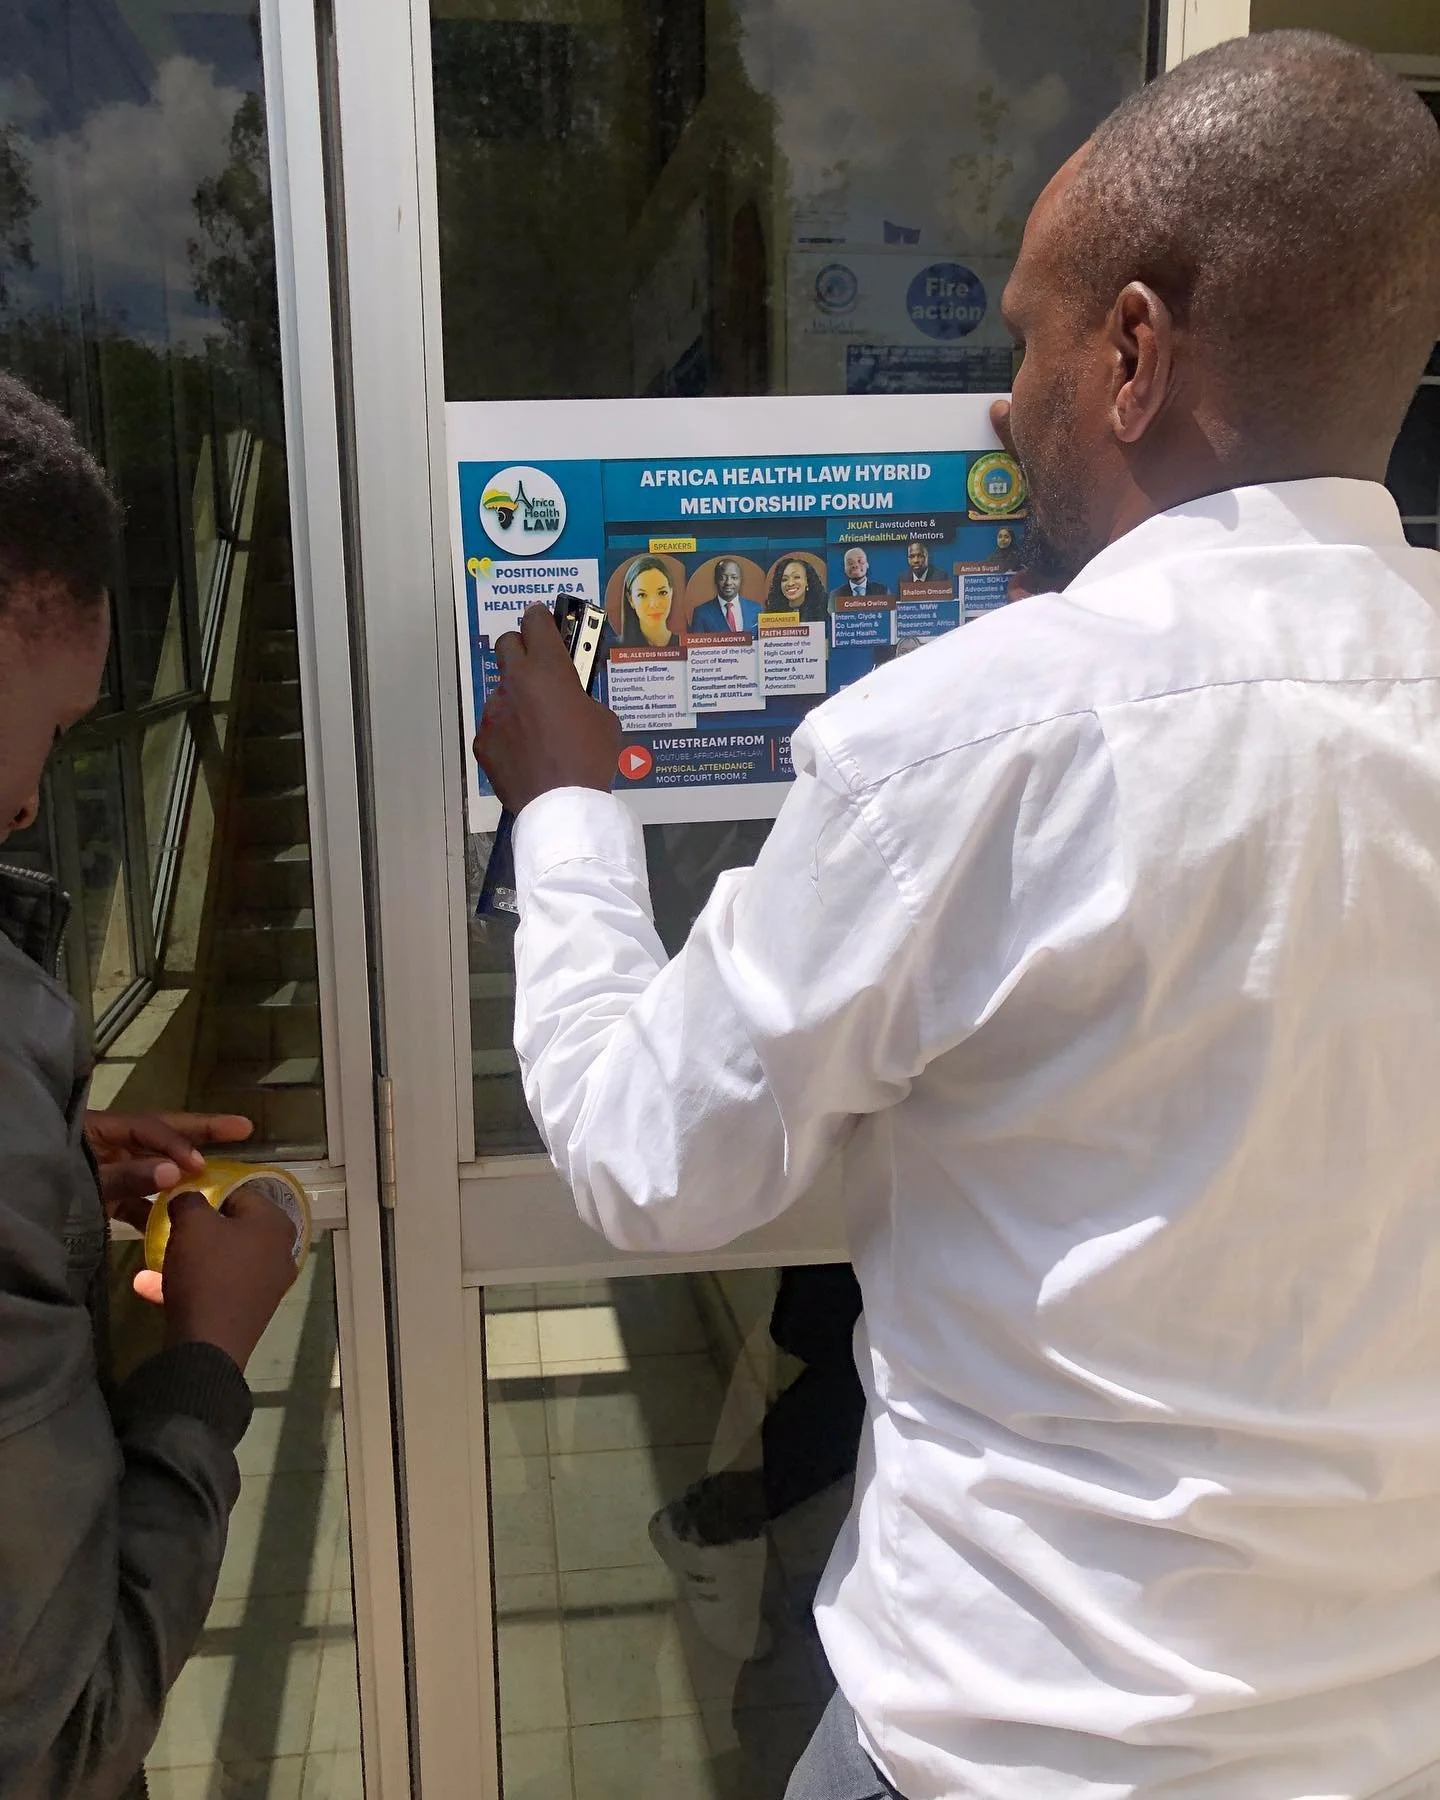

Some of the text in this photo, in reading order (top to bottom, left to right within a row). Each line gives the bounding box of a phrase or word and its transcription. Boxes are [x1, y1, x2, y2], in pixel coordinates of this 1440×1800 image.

[926, 277, 969, 298] Fire
[911, 302, 984, 321] action
[640, 464, 931, 487] AFRICA HEALTH LAW HYBRID
[681, 492, 893, 515] MENTORSHIP FORUM
[524, 508, 560, 518] Health
[523, 519, 560, 531] LAW
[847, 518, 936, 530] JKUAT Lawstudents &
[839, 531, 944, 543] AfricaHealthLaw Mentors
[653, 541, 692, 551] SPEAKERS
[496, 567, 579, 578] POSITIONING
[491, 582, 585, 595] YOURSELF AS A
[484, 600, 529, 612] HEALTH
[844, 600, 866, 608] Collins
[761, 629, 782, 637] FAITH
[740, 648, 756, 656] High
[610, 666, 644, 674] Research
[691, 683, 727, 691] Consultant
[612, 703, 644, 711] Business
[617, 712, 636, 721] ights
[675, 710, 687, 718] the
[652, 735, 765, 750] LIVESTREAM FROM
[655, 764, 697, 774] PHYSICAL
[656, 772, 747, 783] MOOT COURT ROOM 2
